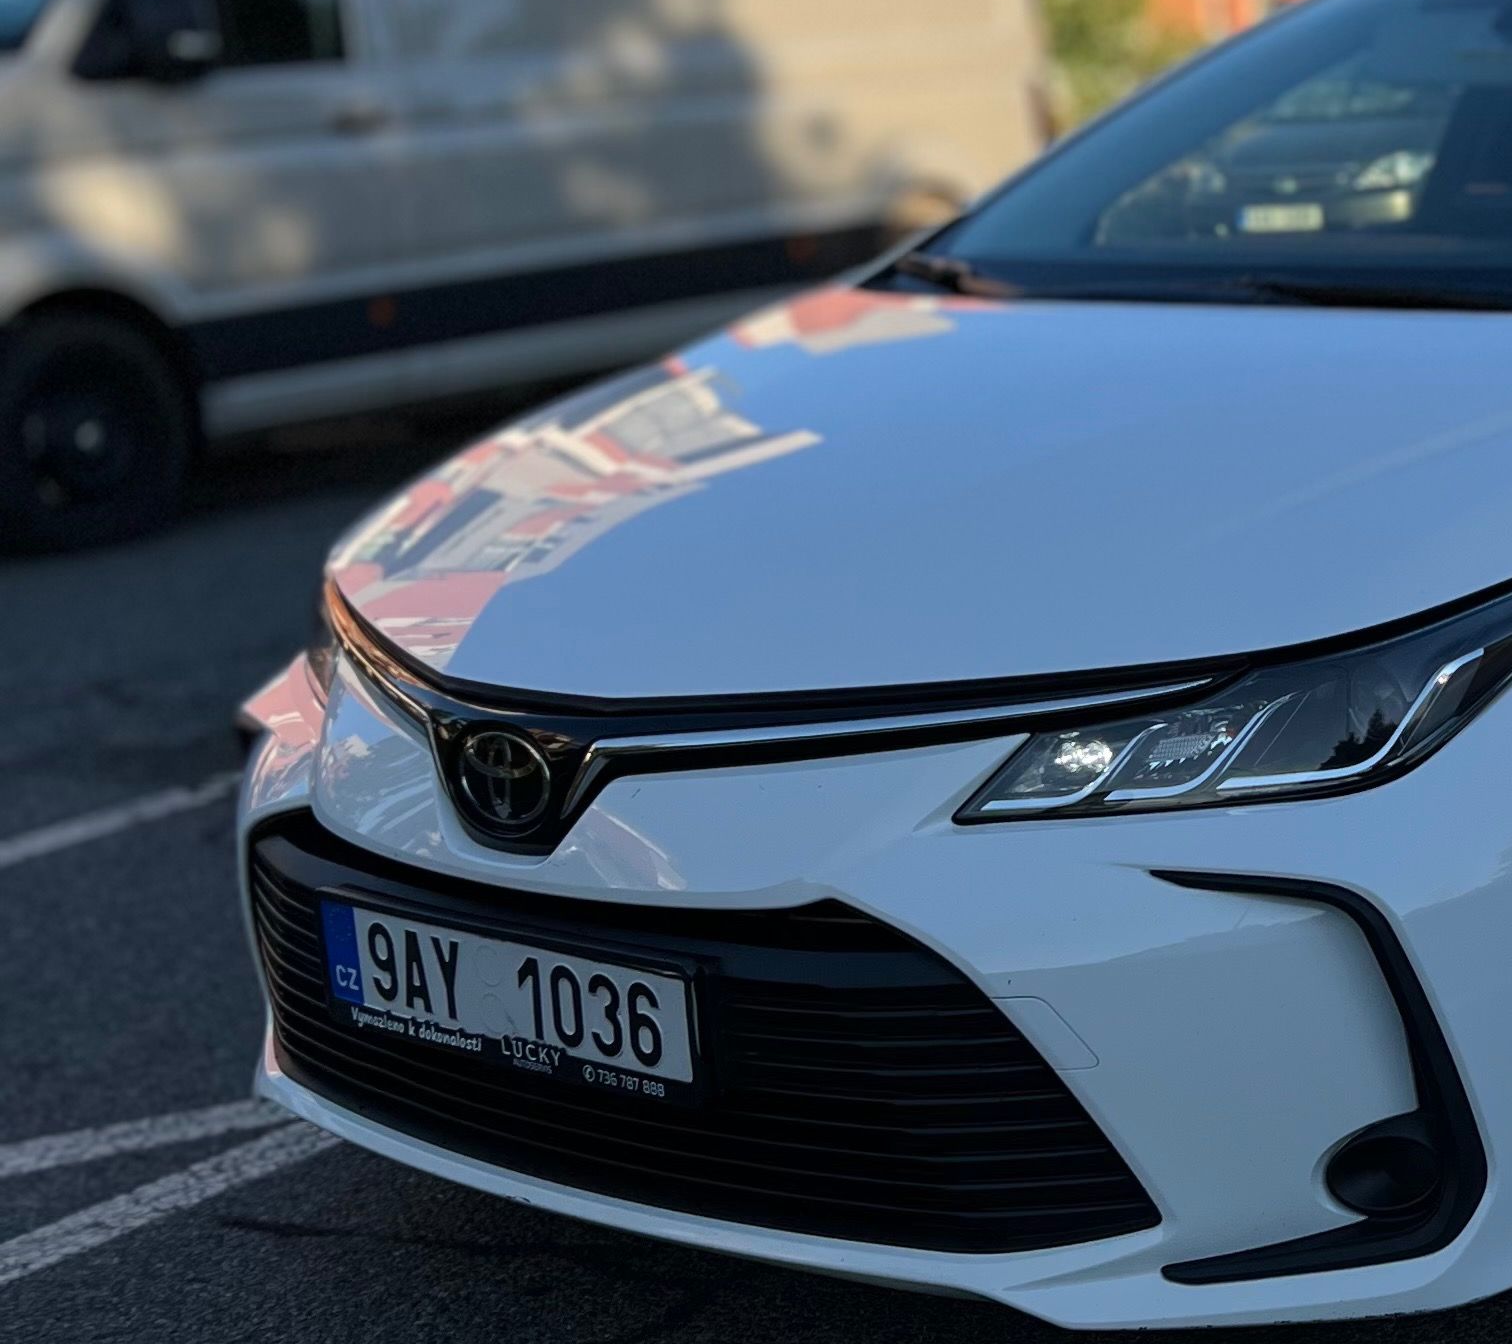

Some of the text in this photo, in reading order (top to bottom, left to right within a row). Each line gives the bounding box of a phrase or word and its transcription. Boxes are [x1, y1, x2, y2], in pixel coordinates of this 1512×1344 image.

[335, 964, 359, 991] CZ
[367, 921, 663, 1067] 9AY 1036
[408, 1019, 416, 1036] k
[501, 1038, 560, 1066] LUCKY
[597, 1068, 618, 1086] 736
[620, 1074, 639, 1091] 787
